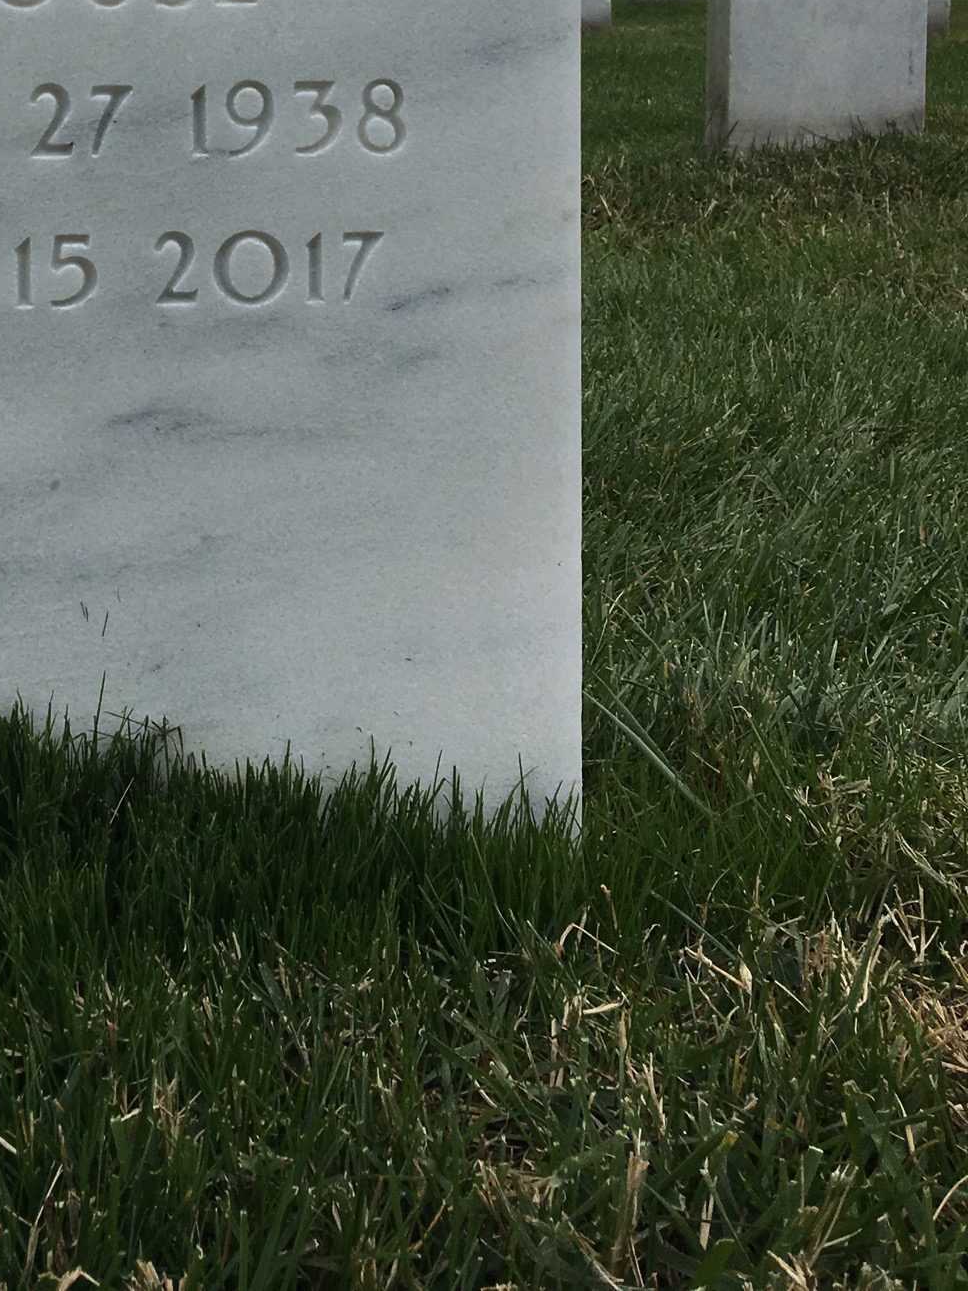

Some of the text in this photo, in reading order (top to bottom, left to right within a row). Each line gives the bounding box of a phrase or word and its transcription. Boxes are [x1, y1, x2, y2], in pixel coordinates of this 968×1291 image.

[30, 82, 134, 160] 27
[190, 78, 408, 158] 1938
[13, 233, 98, 310] 15
[154, 229, 385, 307] 2017
